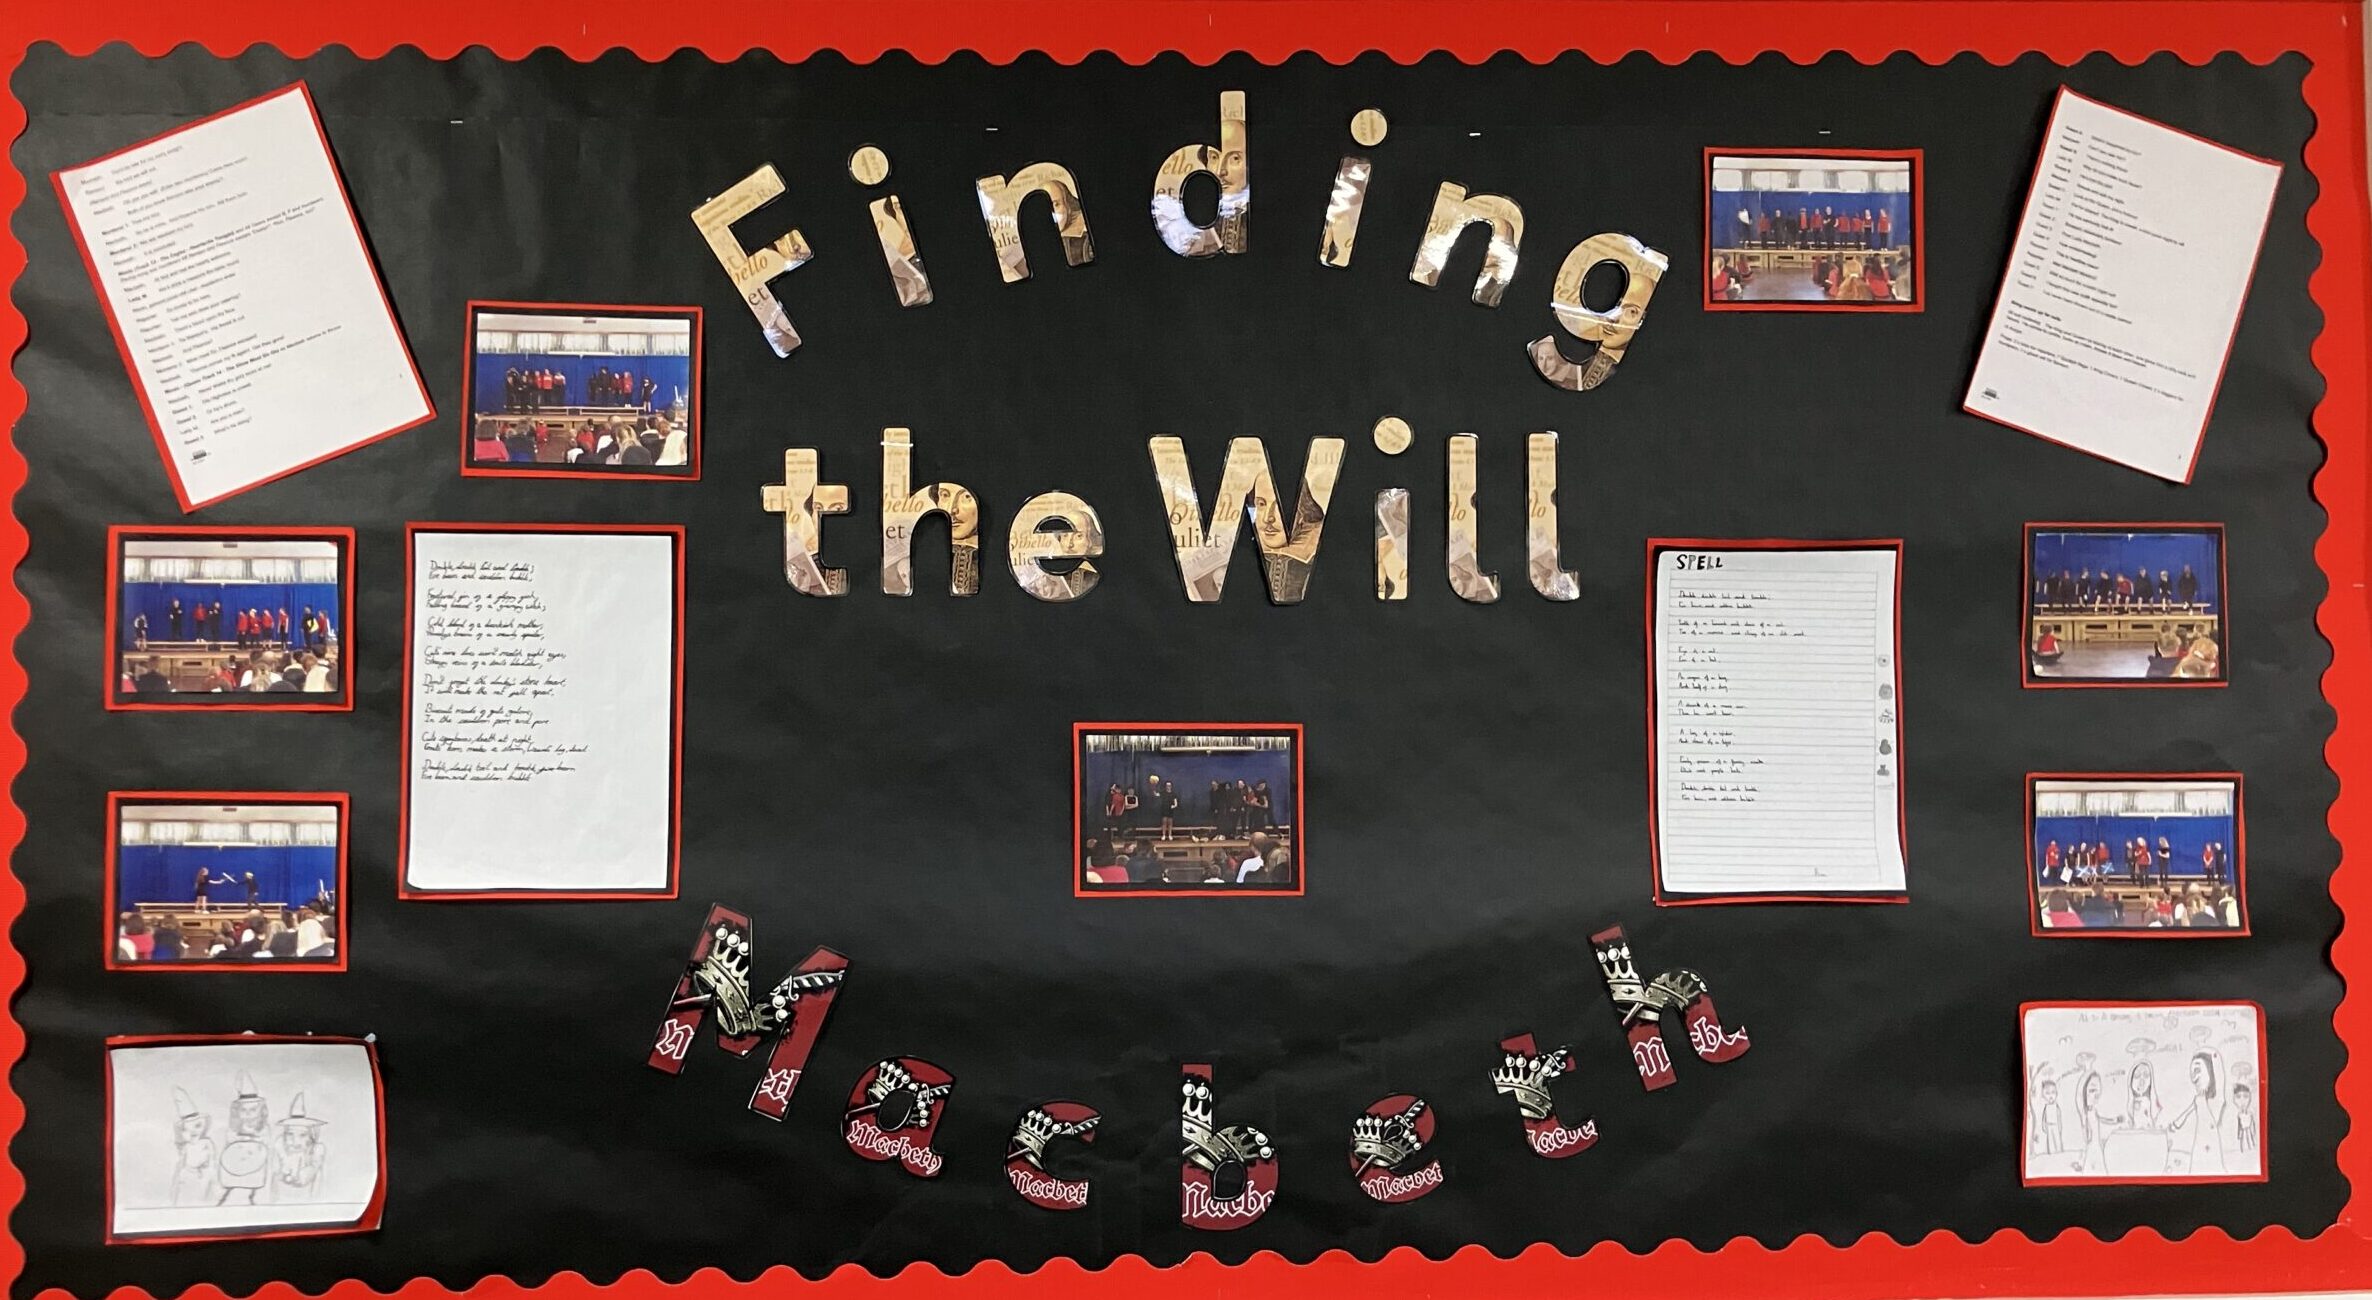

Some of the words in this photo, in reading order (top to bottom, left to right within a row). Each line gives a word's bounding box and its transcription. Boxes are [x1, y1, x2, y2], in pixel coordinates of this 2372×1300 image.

[690, 88, 1670, 391] Finding
[760, 426, 1106, 602] the
[1147, 415, 1581, 604] Will
[1676, 553, 1724, 571] SPELL
[647, 902, 1751, 1231] Macbeth
